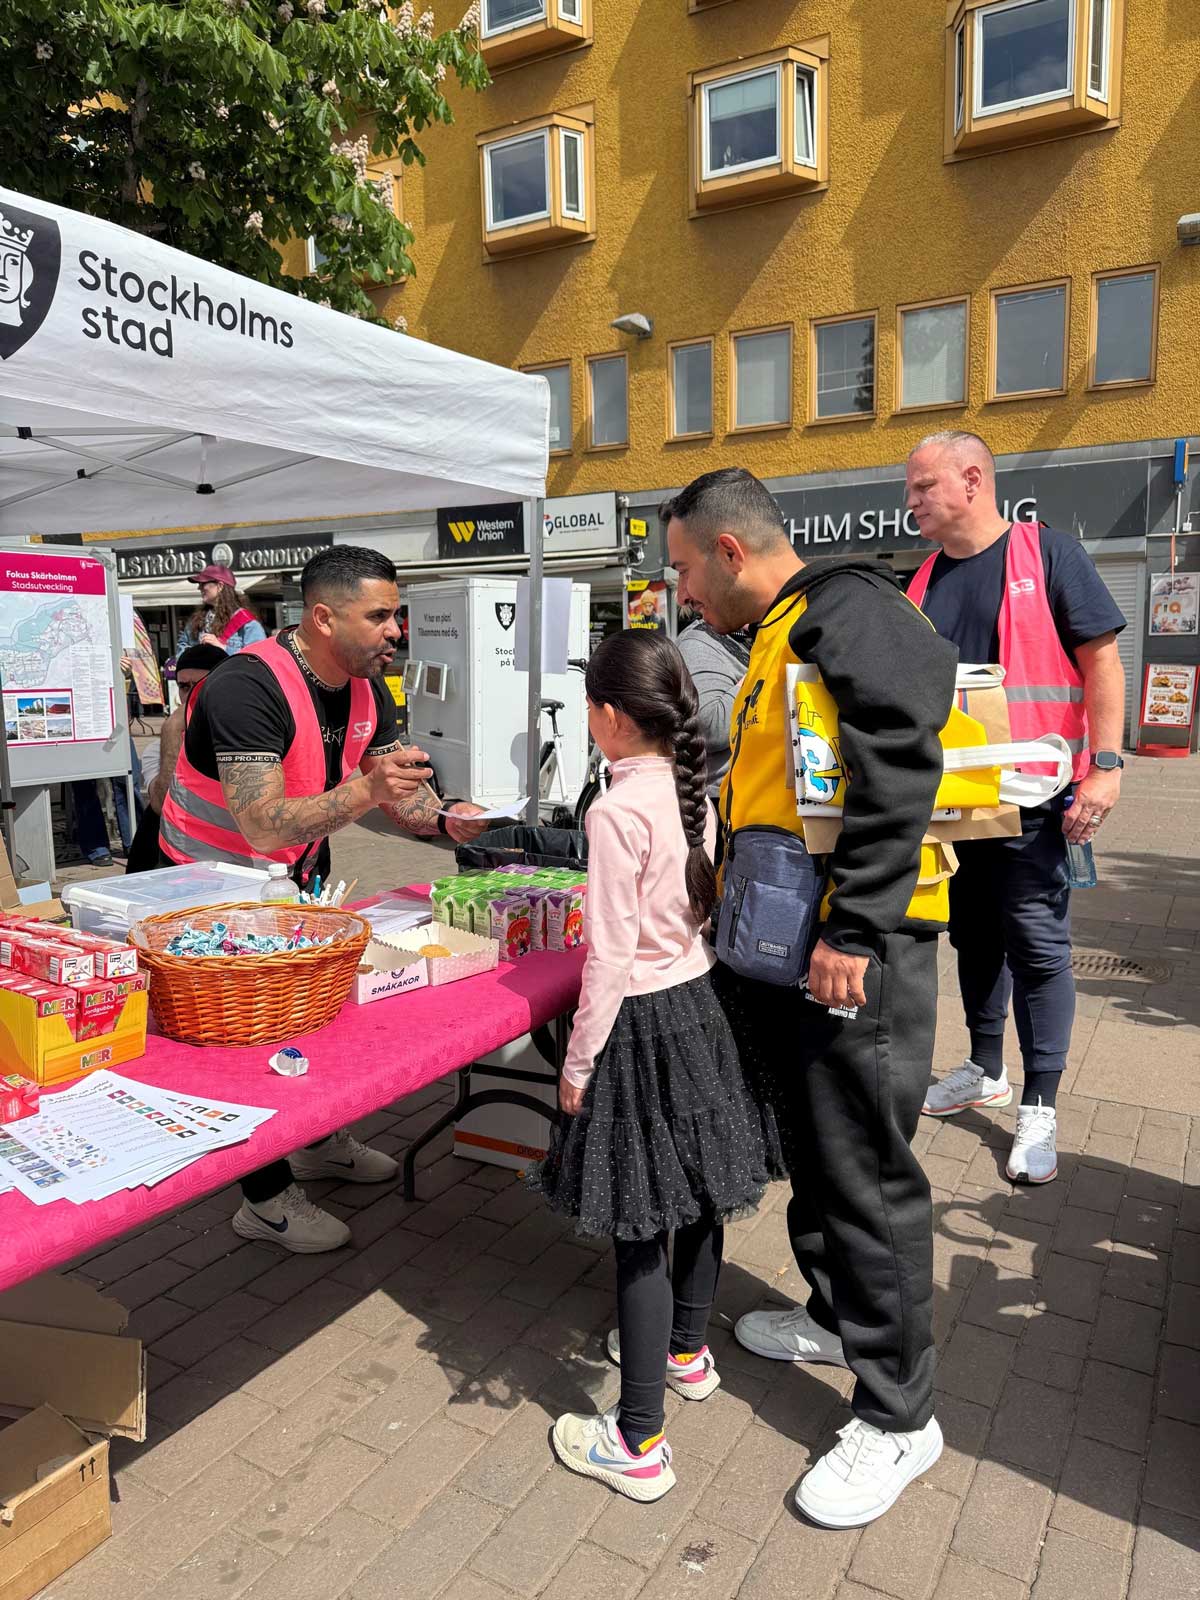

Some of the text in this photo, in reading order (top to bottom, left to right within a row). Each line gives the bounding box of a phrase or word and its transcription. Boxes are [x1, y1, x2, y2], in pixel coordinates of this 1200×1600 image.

[78, 250, 294, 348] Stockholms
[82, 306, 173, 358] stad
[476, 520, 514, 531] Western
[554, 513, 605, 528] GLOBAL
[477, 530, 504, 541] Union
[784, 513, 851, 545] HLM
[118, 545, 330, 576] LSTRÖMS KONDITO
[6, 570, 77, 582] Fokus Skärholmen
[12, 581, 73, 592] Stadsutveckling
[500, 658, 510, 667] på
[117, 980, 143, 996] MER
[371, 975, 420, 995] SMÅKAKOR
[43, 998, 76, 1015] MER
[86, 989, 115, 1009] MER
[84, 1004, 115, 1015] Jordgubbe
[81, 1048, 111, 1068] MER
